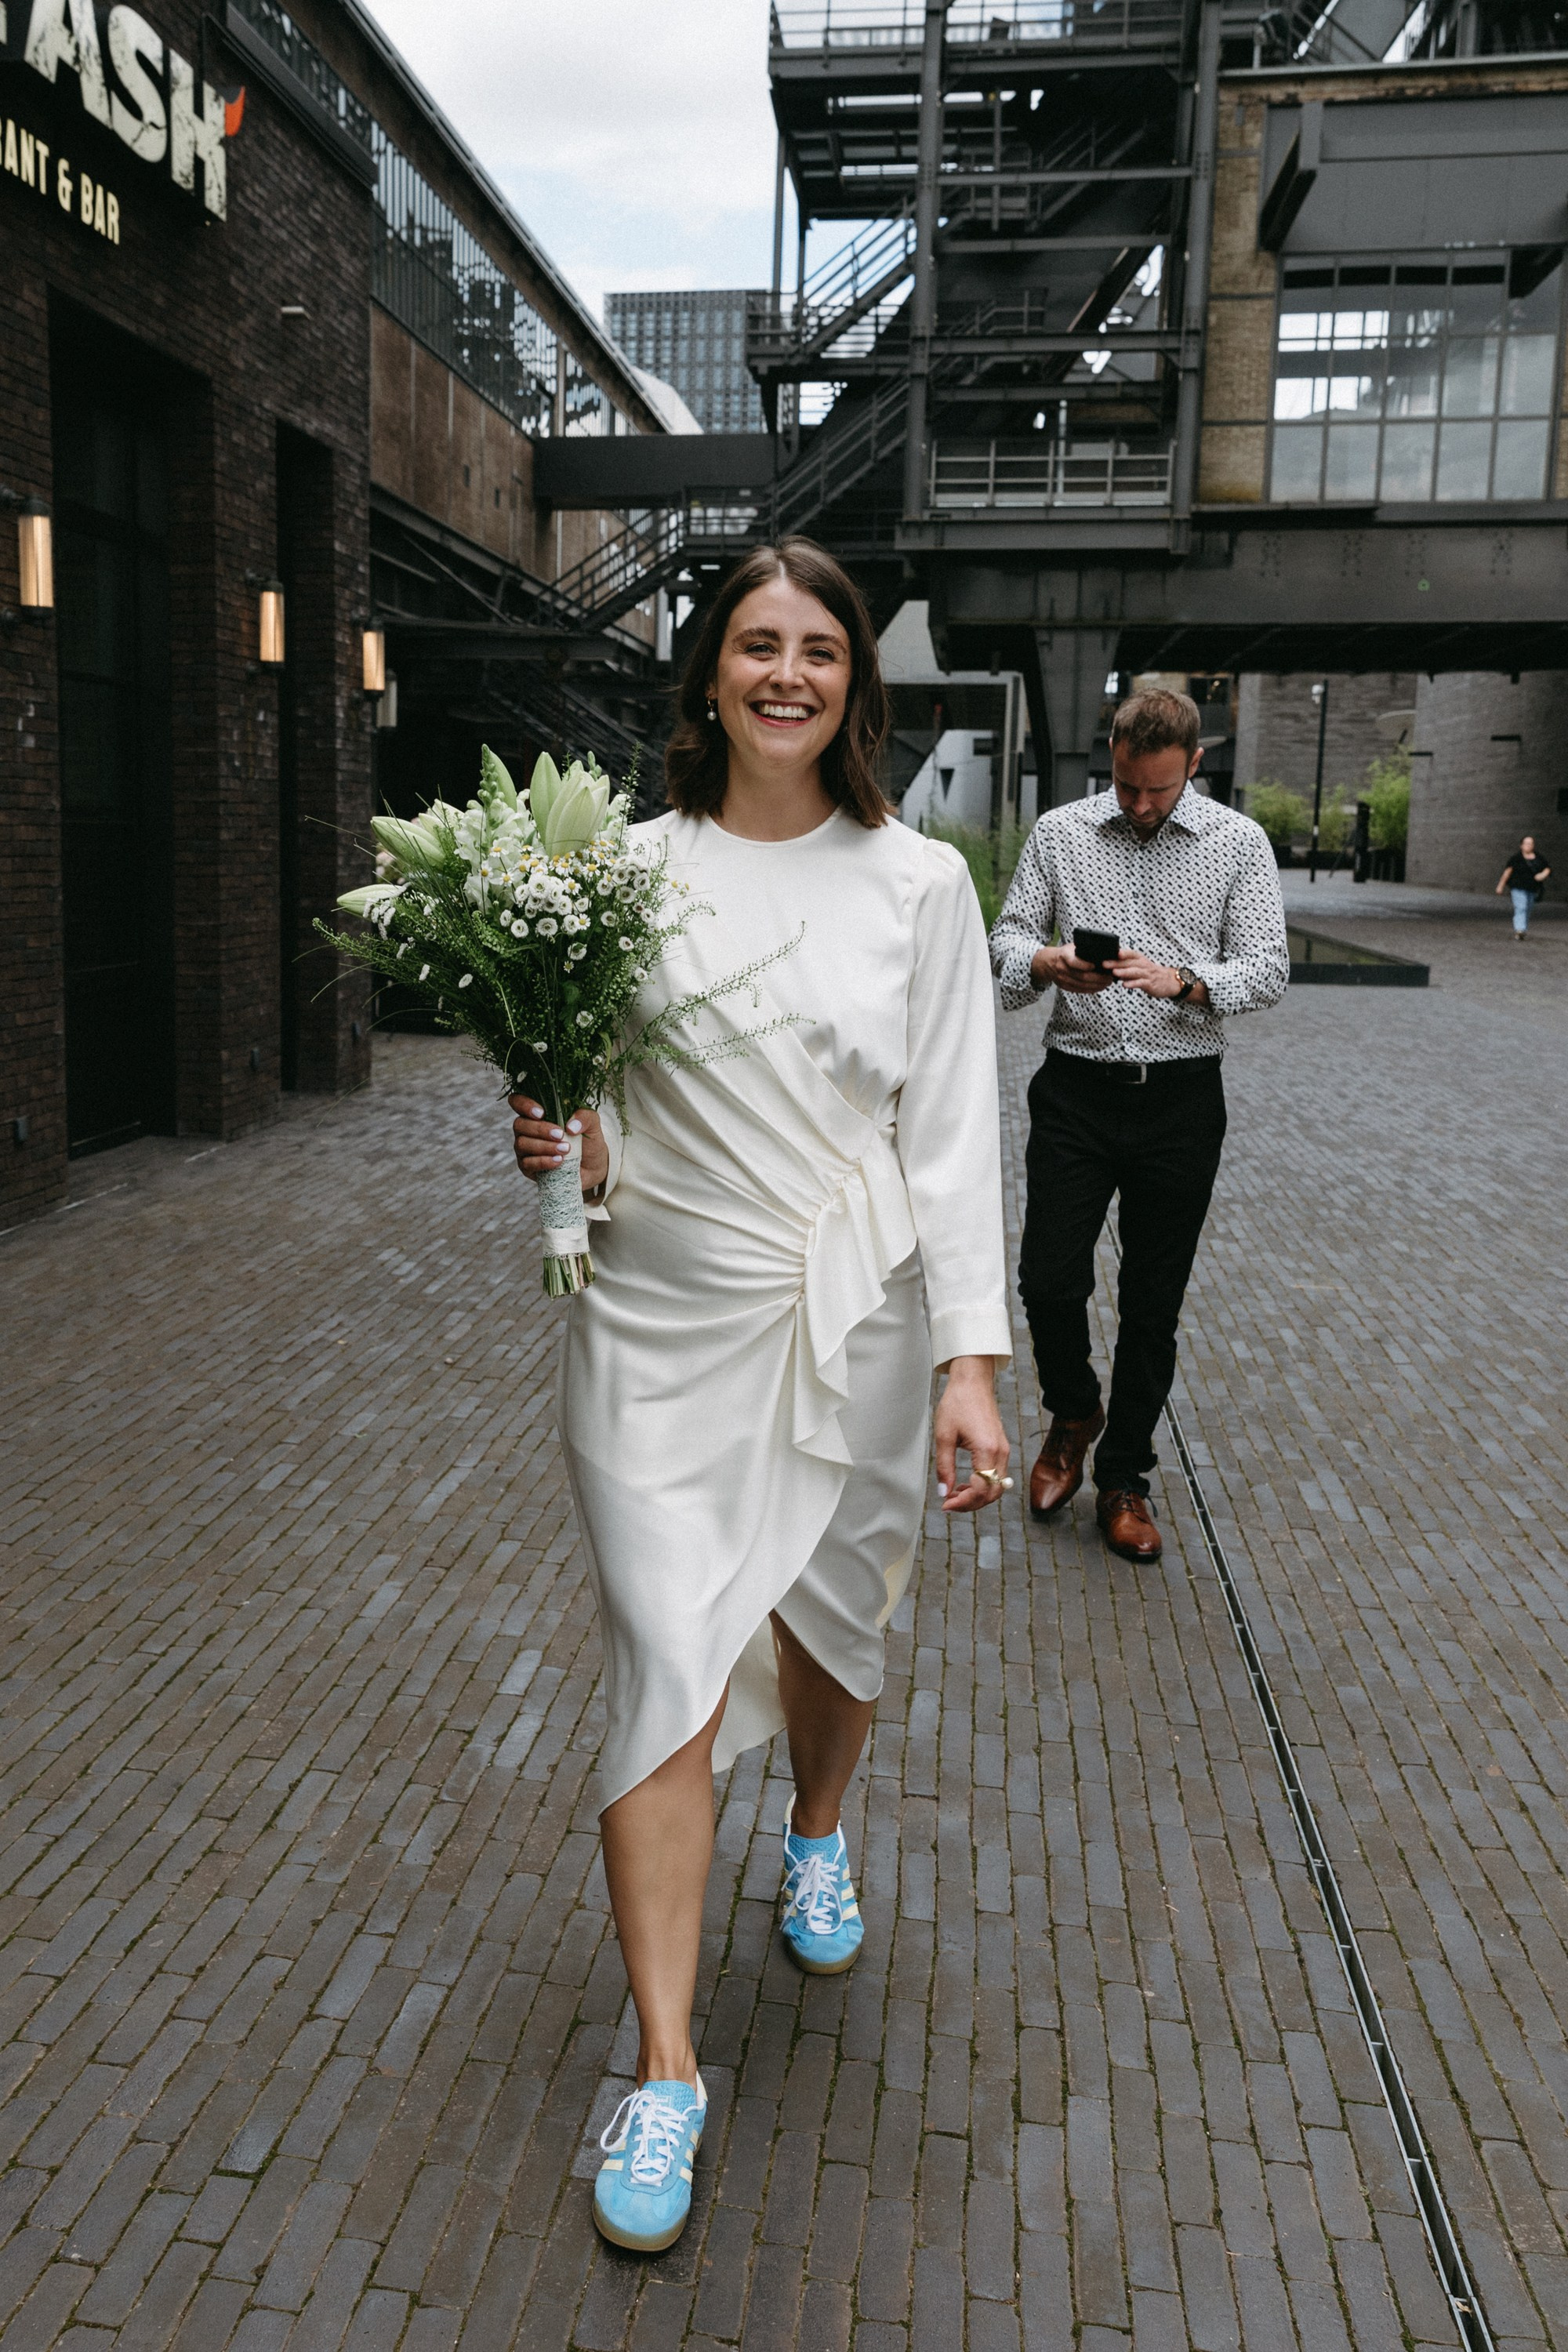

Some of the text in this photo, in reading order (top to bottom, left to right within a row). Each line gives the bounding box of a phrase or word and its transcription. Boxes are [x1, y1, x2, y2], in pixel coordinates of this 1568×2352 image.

[0, 0, 227, 223] ASH
[0, 118, 120, 245] ANT & BAR
